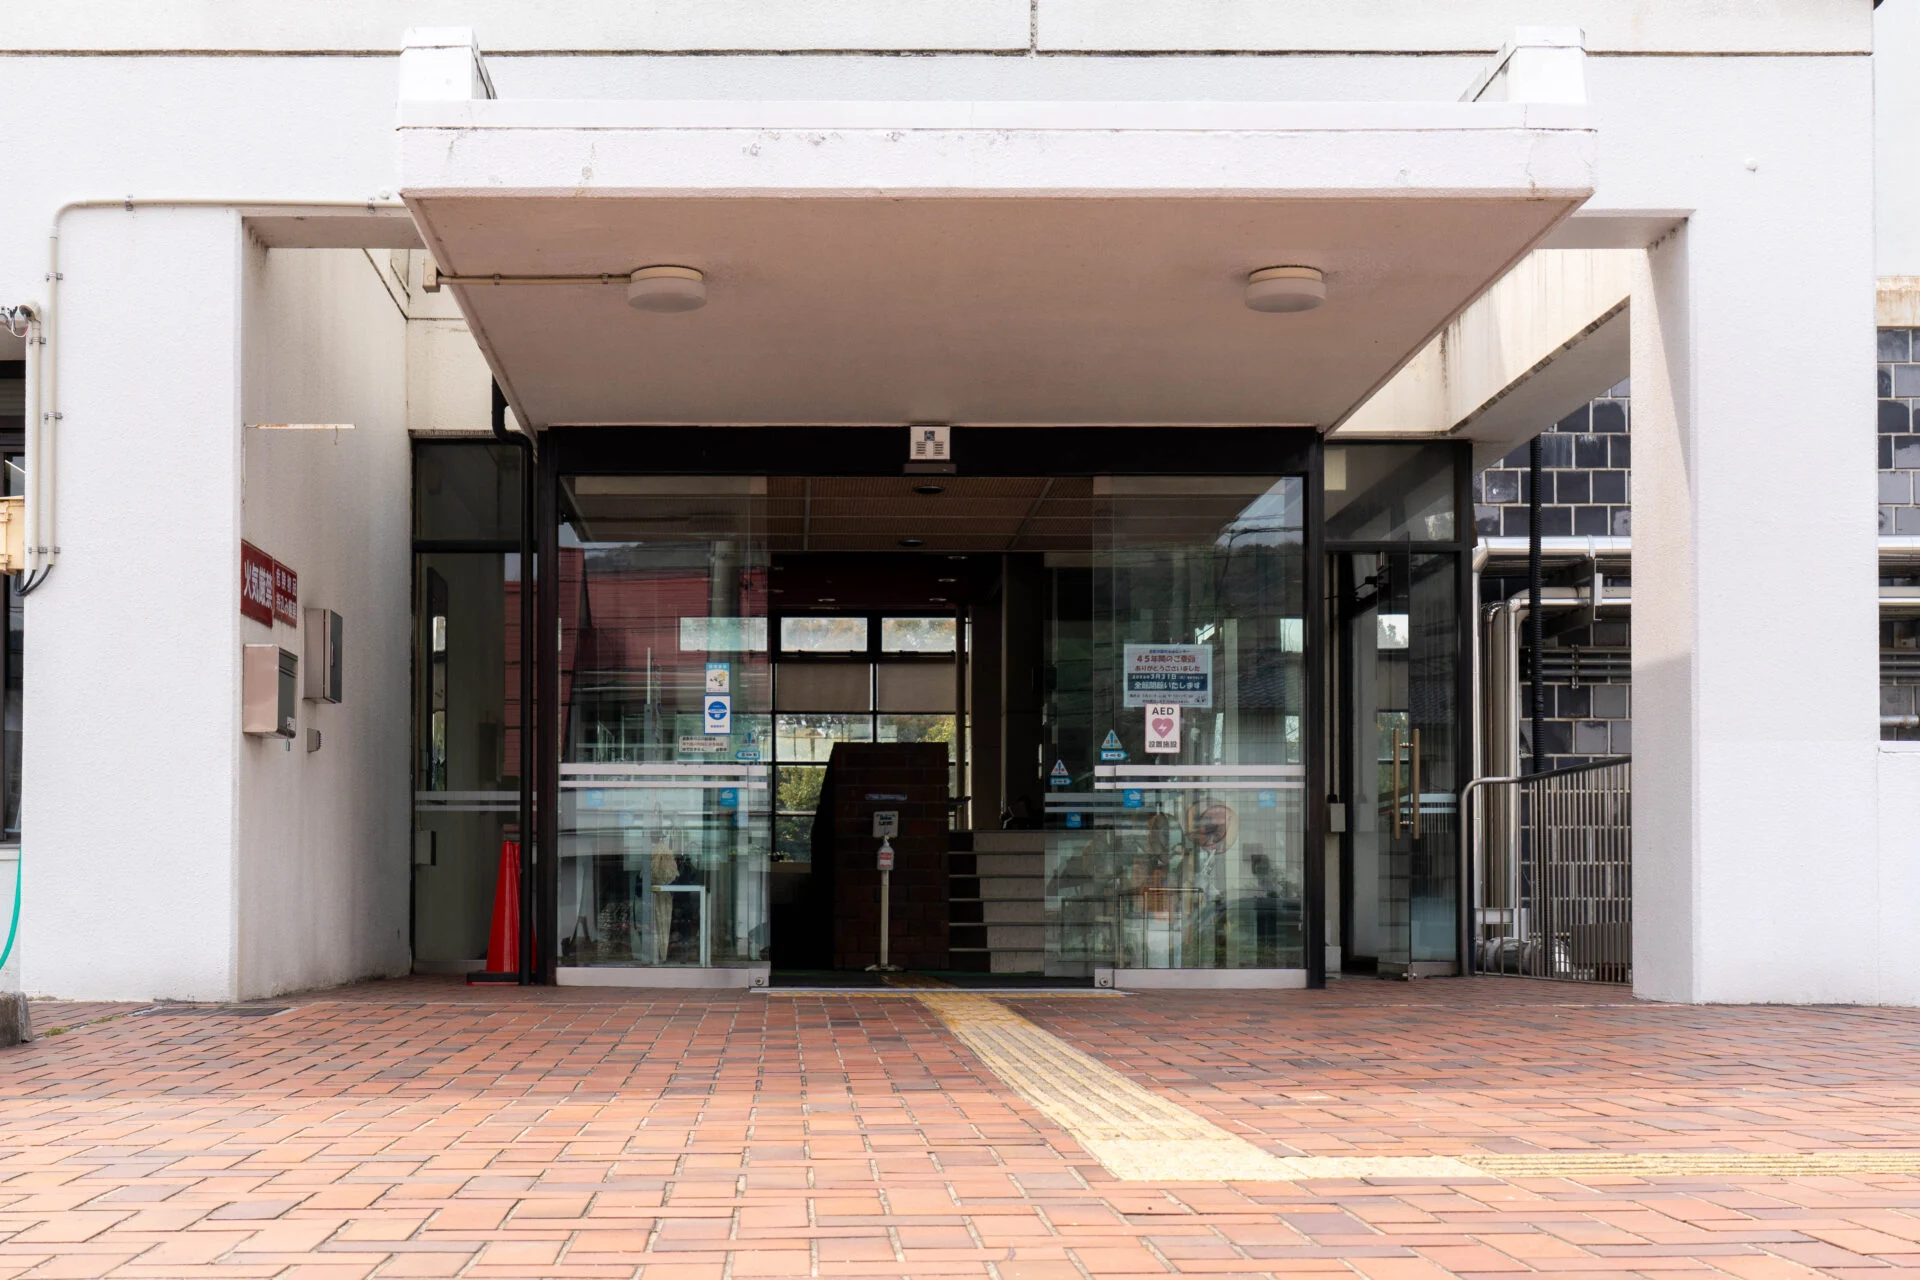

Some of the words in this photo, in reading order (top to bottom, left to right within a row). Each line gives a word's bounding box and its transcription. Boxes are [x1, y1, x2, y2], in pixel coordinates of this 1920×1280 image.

[244, 559, 273, 608] 火気厳禁
[1152, 707, 1175, 716] AED
[1148, 740, 1177, 749] 設置施設
